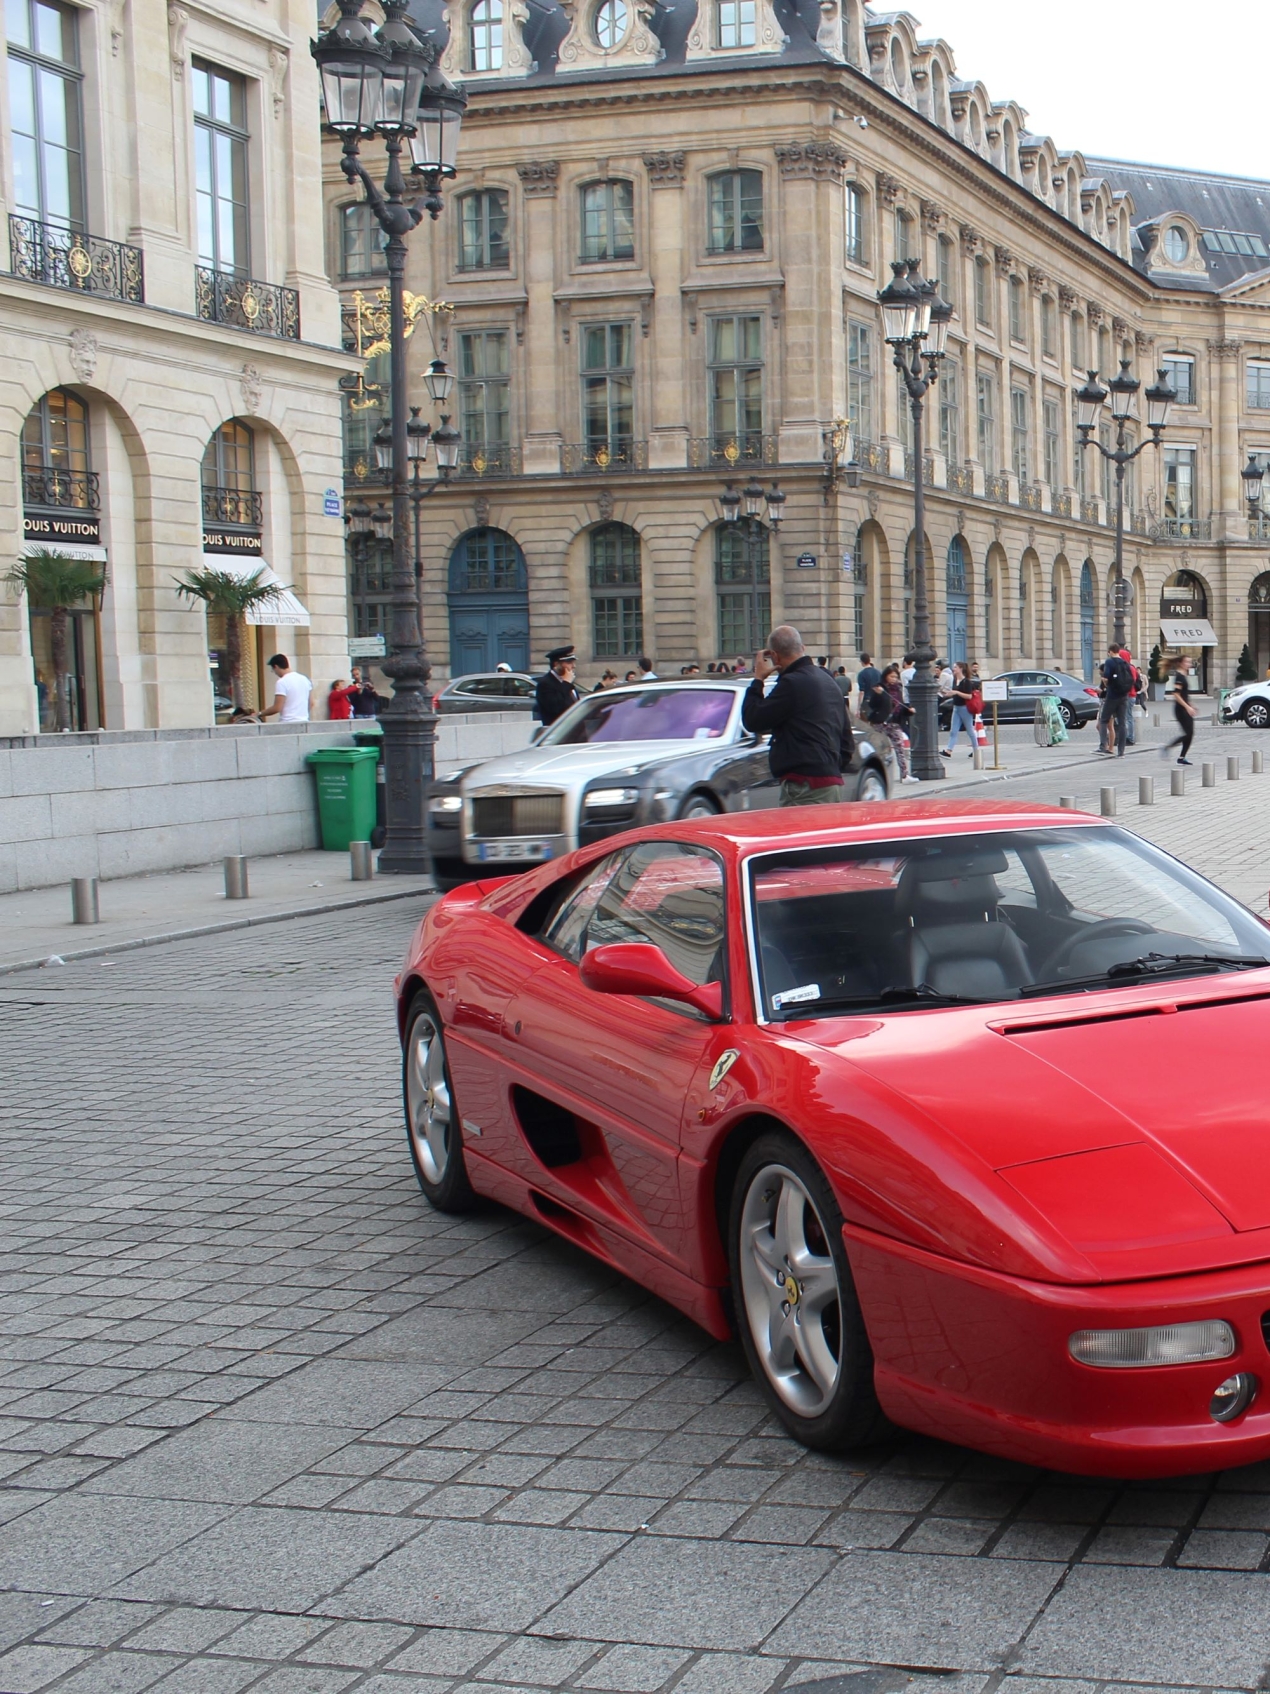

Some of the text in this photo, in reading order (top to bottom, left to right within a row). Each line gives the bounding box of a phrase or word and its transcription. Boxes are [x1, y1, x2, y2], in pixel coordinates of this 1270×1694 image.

[23, 519, 98, 535] OUIS VUITTON
[202, 533, 261, 548] OUIS VUITTON
[1170, 605, 1192, 614] FRED
[275, 616, 301, 625] VUITTON
[1174, 629, 1203, 638] FRED
